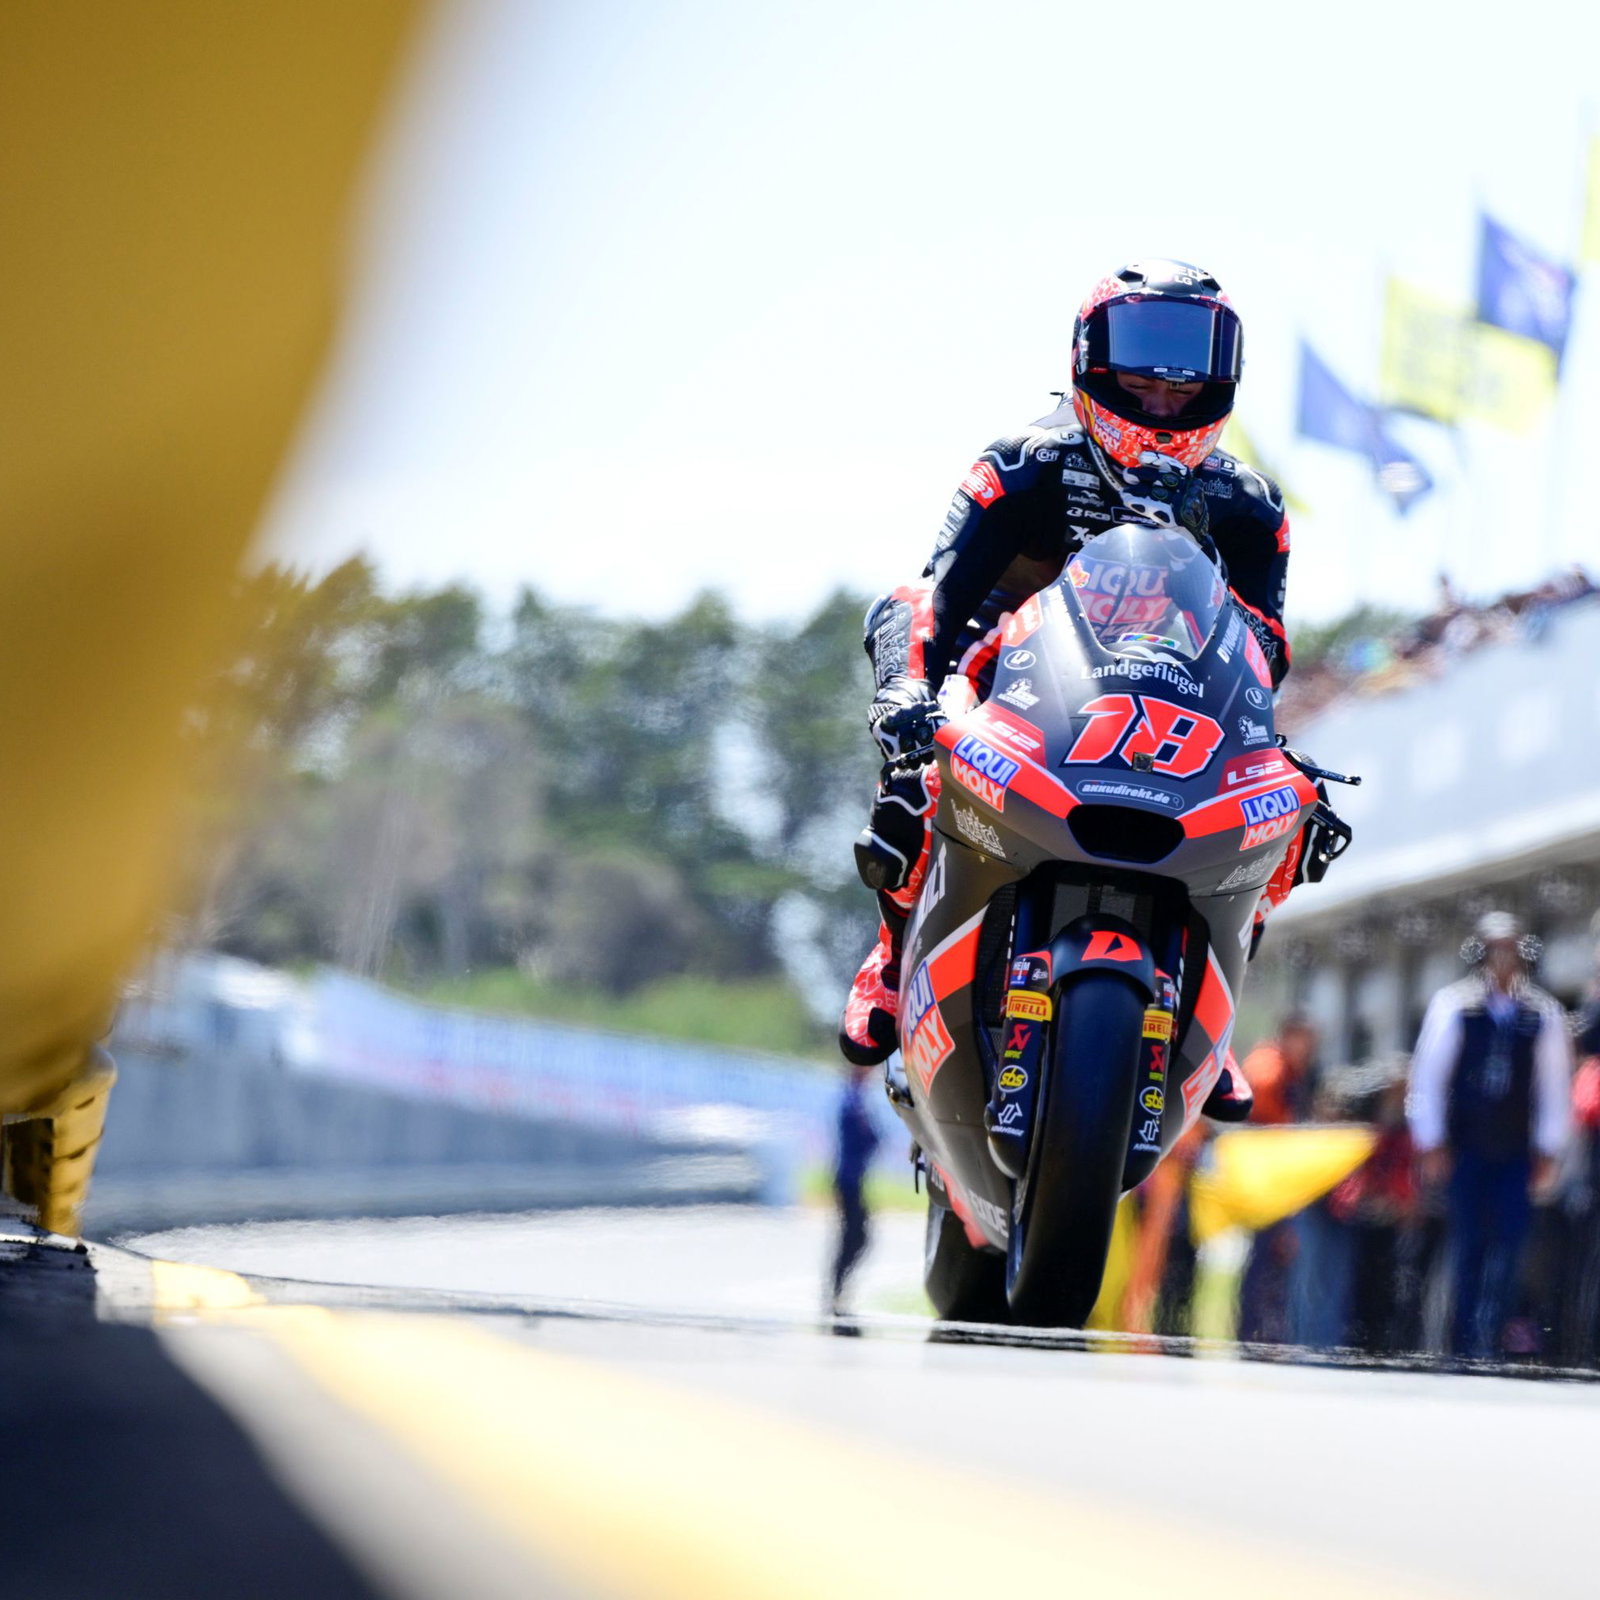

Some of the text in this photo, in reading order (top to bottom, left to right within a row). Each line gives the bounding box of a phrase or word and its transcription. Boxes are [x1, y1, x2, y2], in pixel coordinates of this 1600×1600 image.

[1084, 510, 1111, 521] RCB
[1080, 659, 1204, 698] Landgeflügel
[954, 735, 1016, 786] LIQUI
[1227, 760, 1286, 786] LS2
[953, 757, 1004, 806] MOLY
[1082, 782, 1170, 805] akkudirekt.de
[1243, 787, 1299, 825] LIQUI
[1245, 812, 1299, 846] MOLY
[1008, 995, 1047, 1017] PIRELLI
